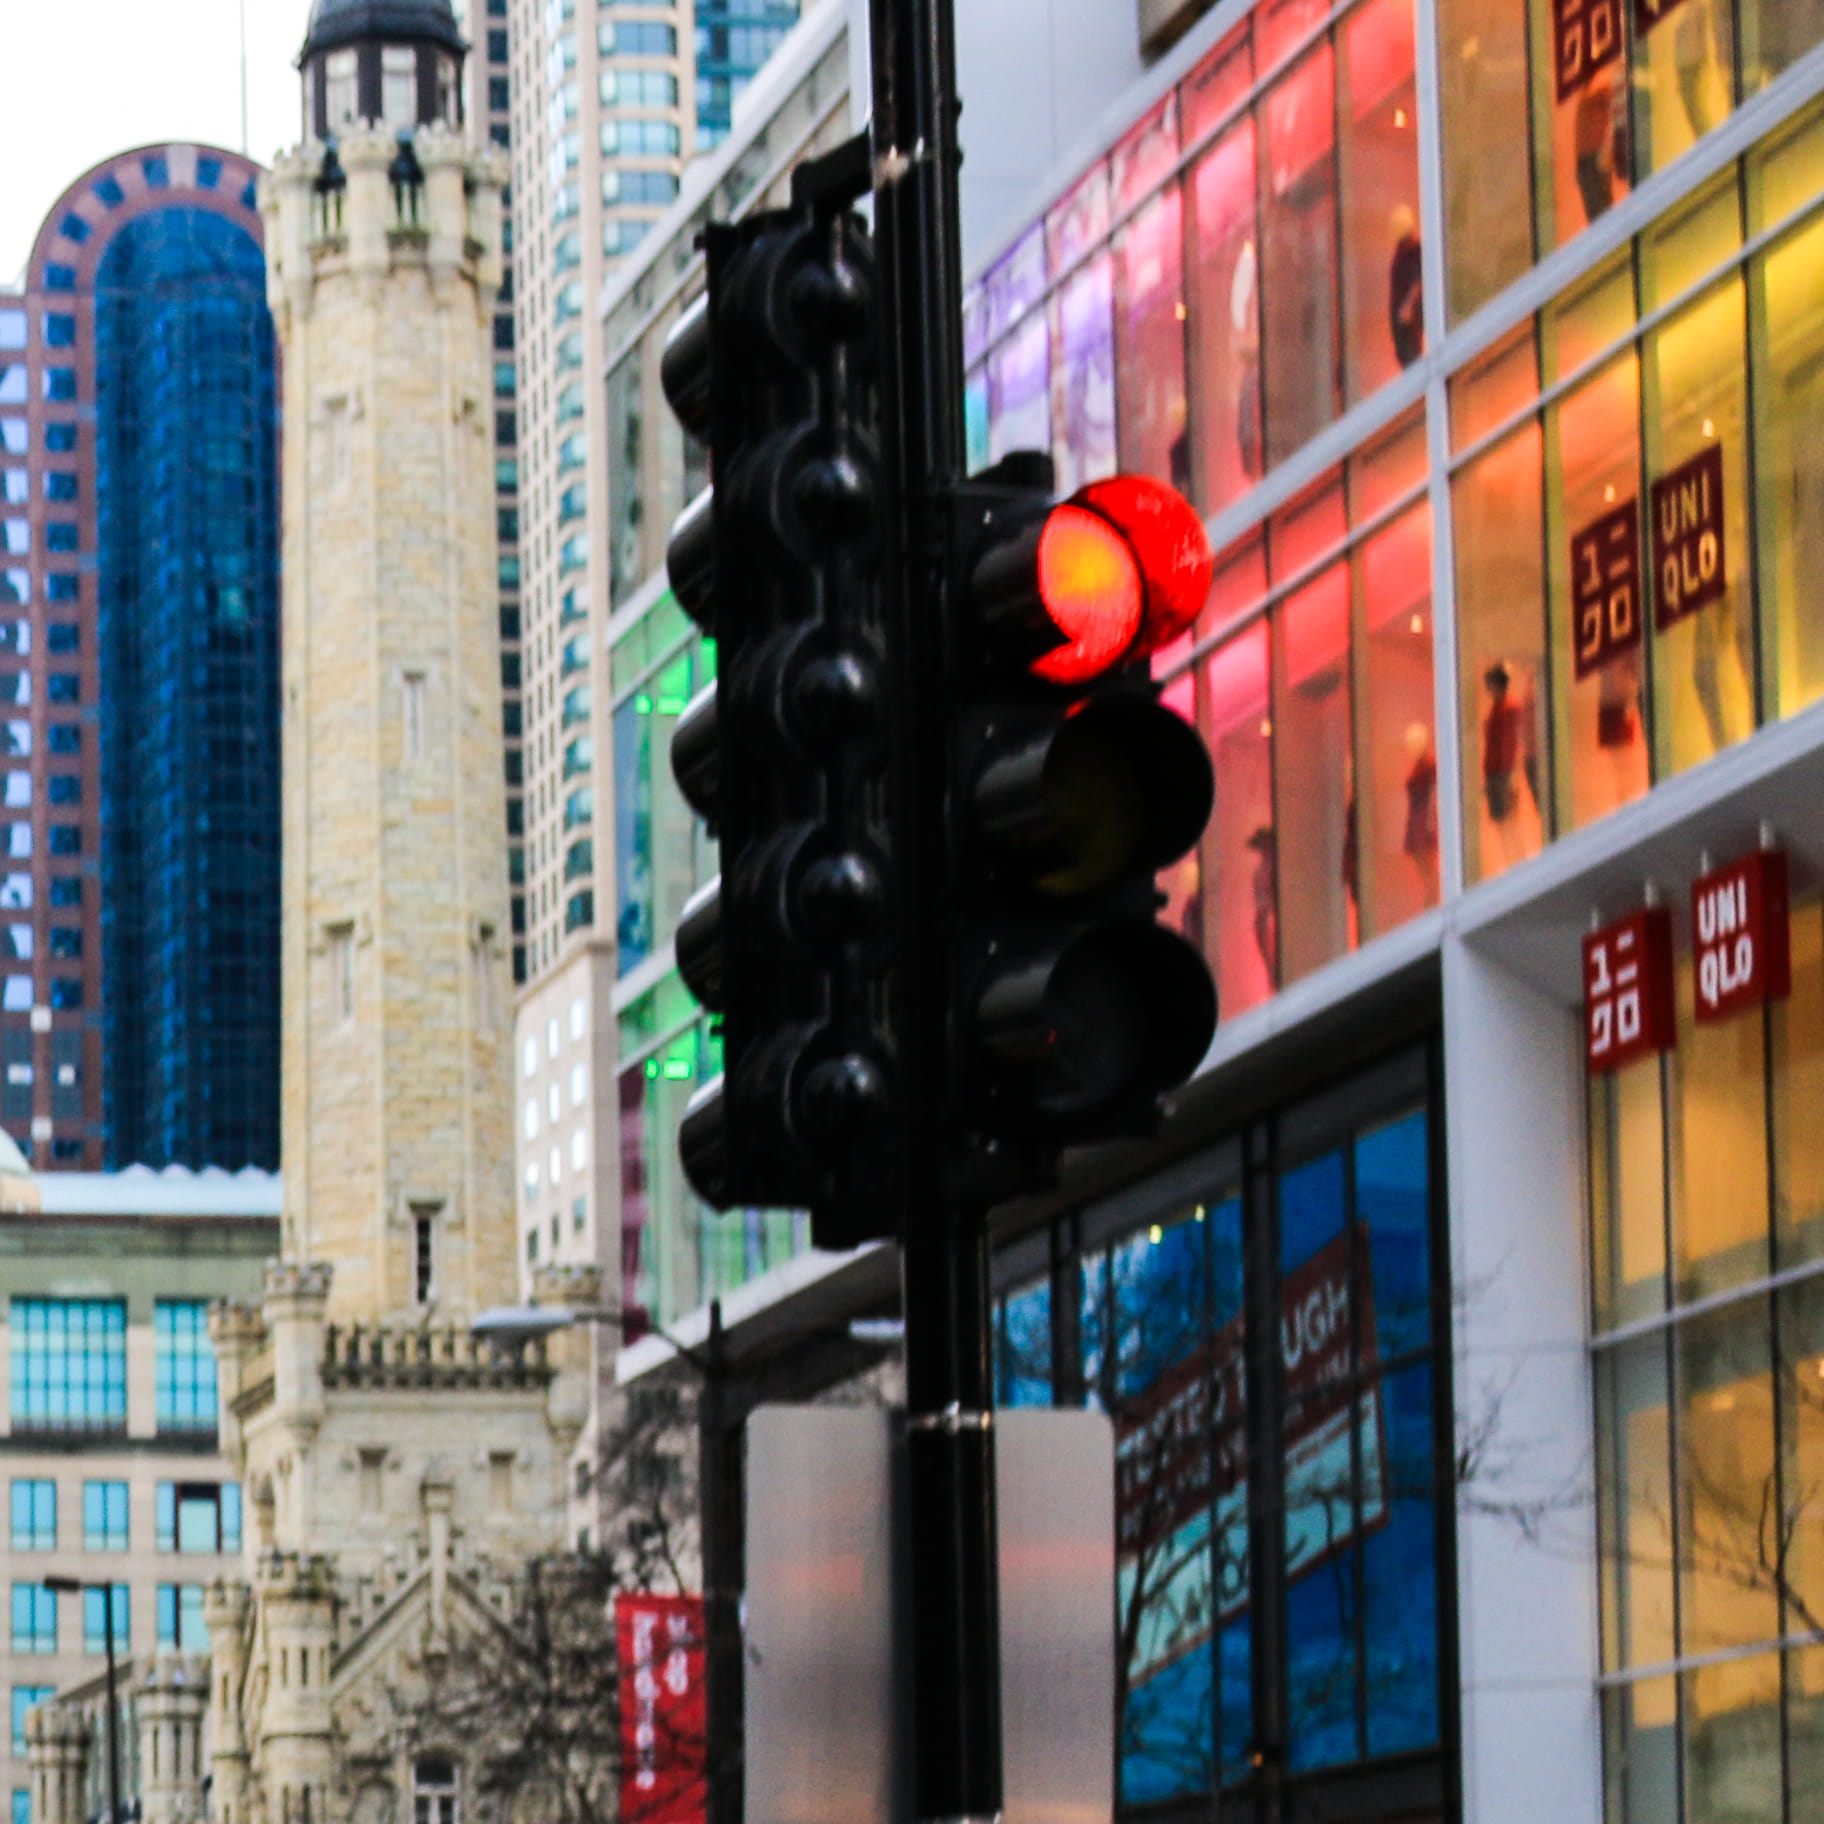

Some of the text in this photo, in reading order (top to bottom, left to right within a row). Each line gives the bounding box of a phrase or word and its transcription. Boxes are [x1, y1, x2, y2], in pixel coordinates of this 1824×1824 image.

[1661, 470, 1710, 545] UNI
[1663, 531, 1718, 611] QLO
[1697, 873, 1747, 944] UNI
[1590, 928, 1637, 997] ユニ
[1700, 932, 1753, 1007] QLO
